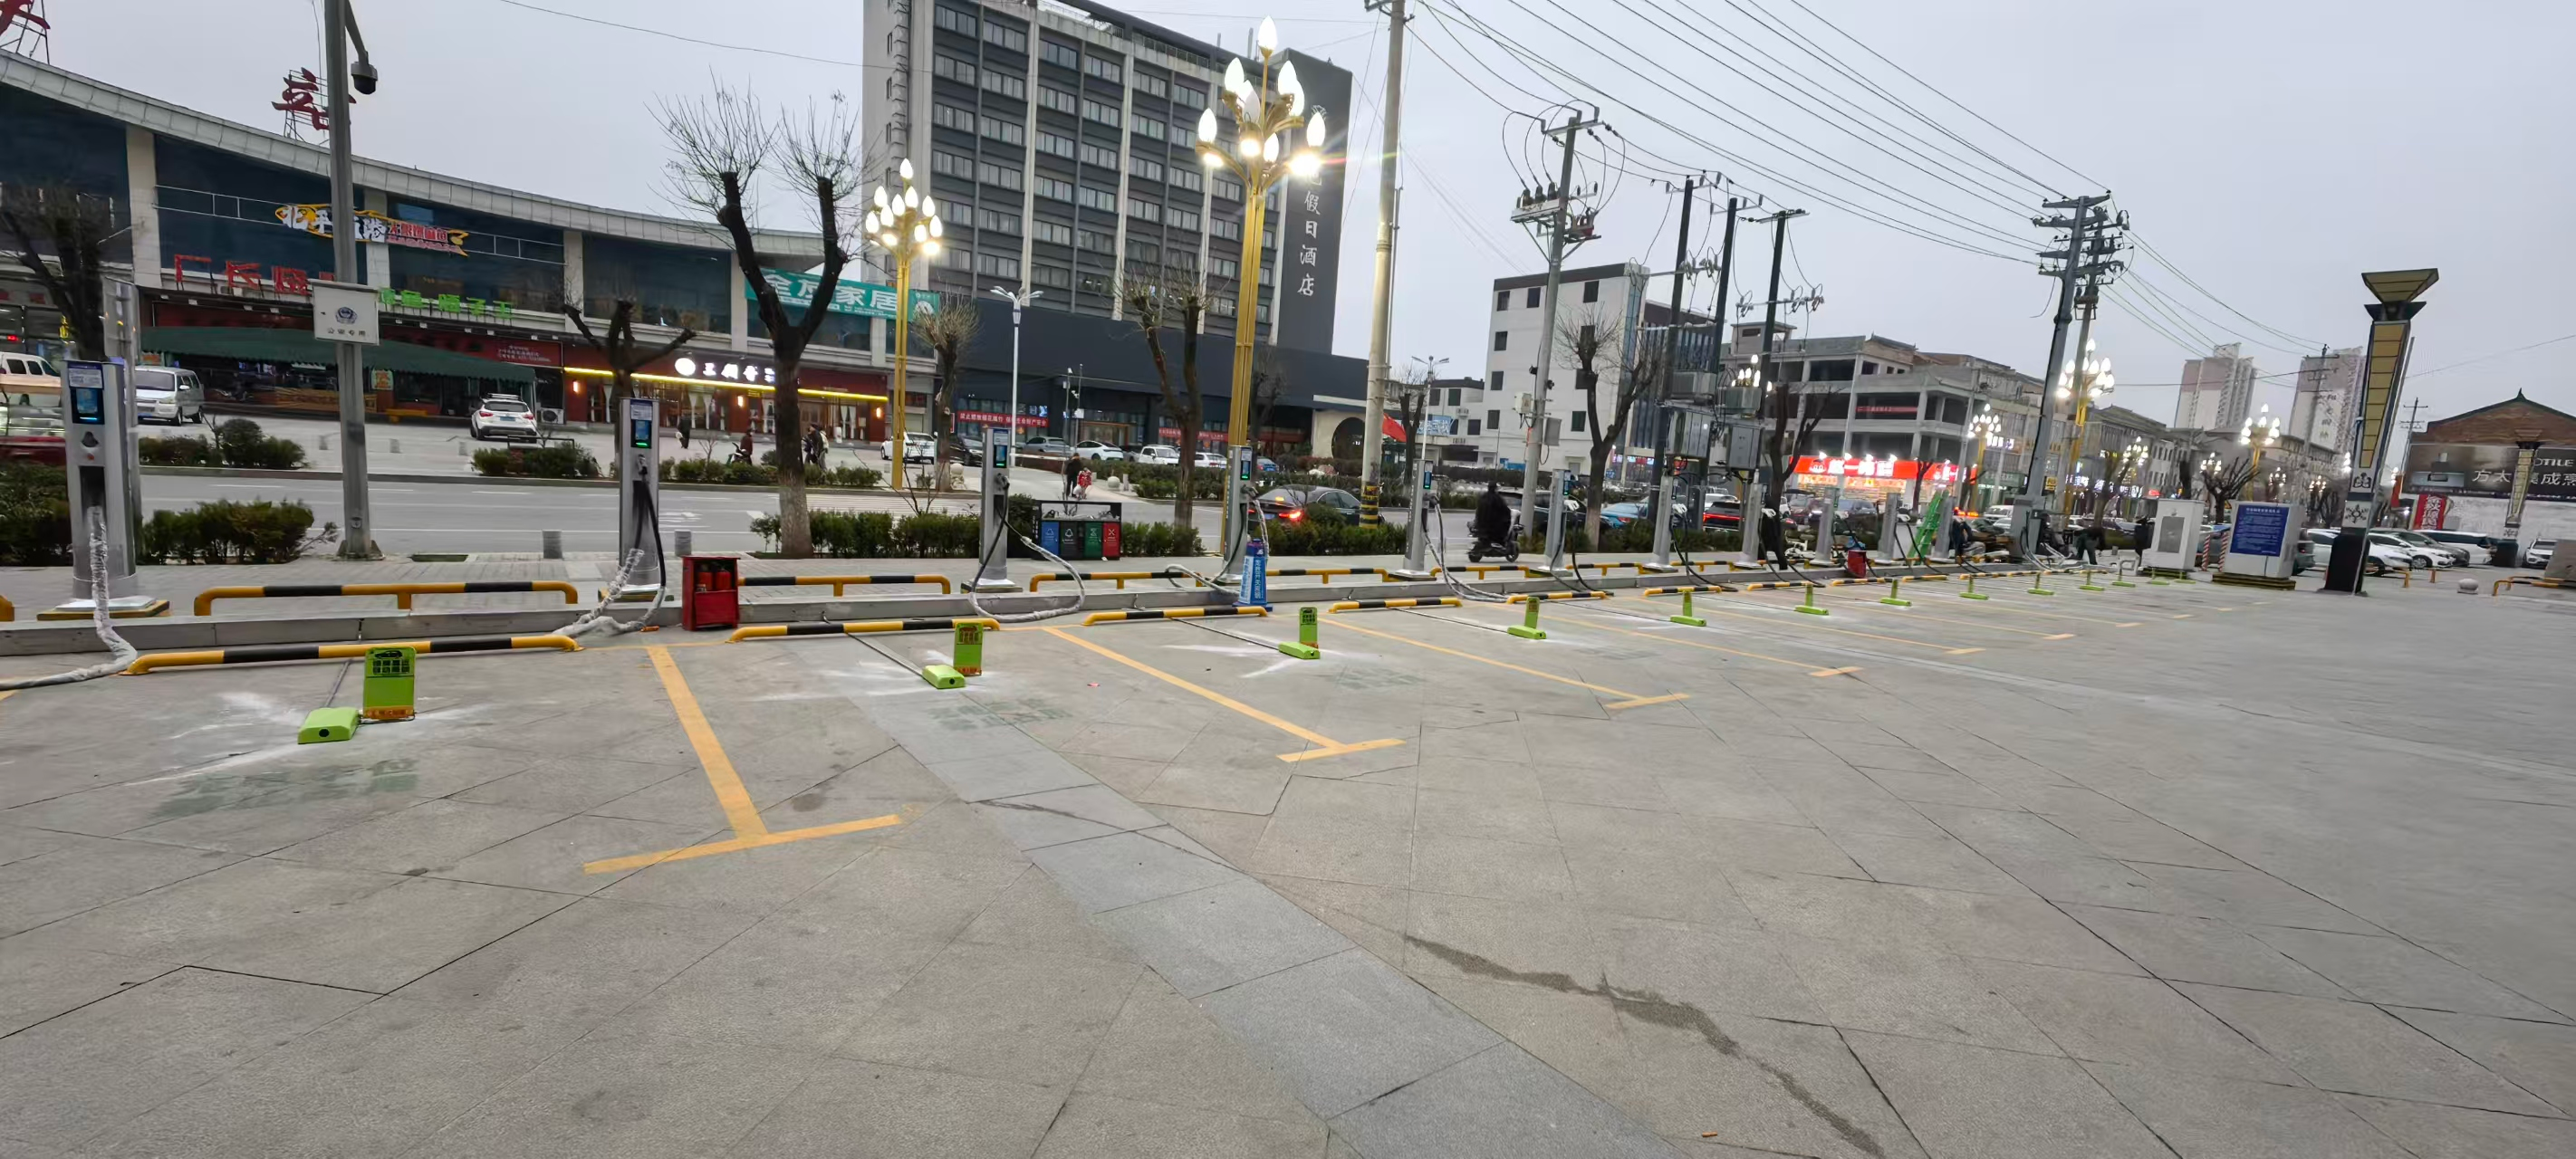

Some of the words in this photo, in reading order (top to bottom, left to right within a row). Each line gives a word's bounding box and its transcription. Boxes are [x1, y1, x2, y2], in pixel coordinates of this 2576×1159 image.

[1298, 169, 1322, 297] 假日酒店
[2534, 457, 2574, 466] OTILE
